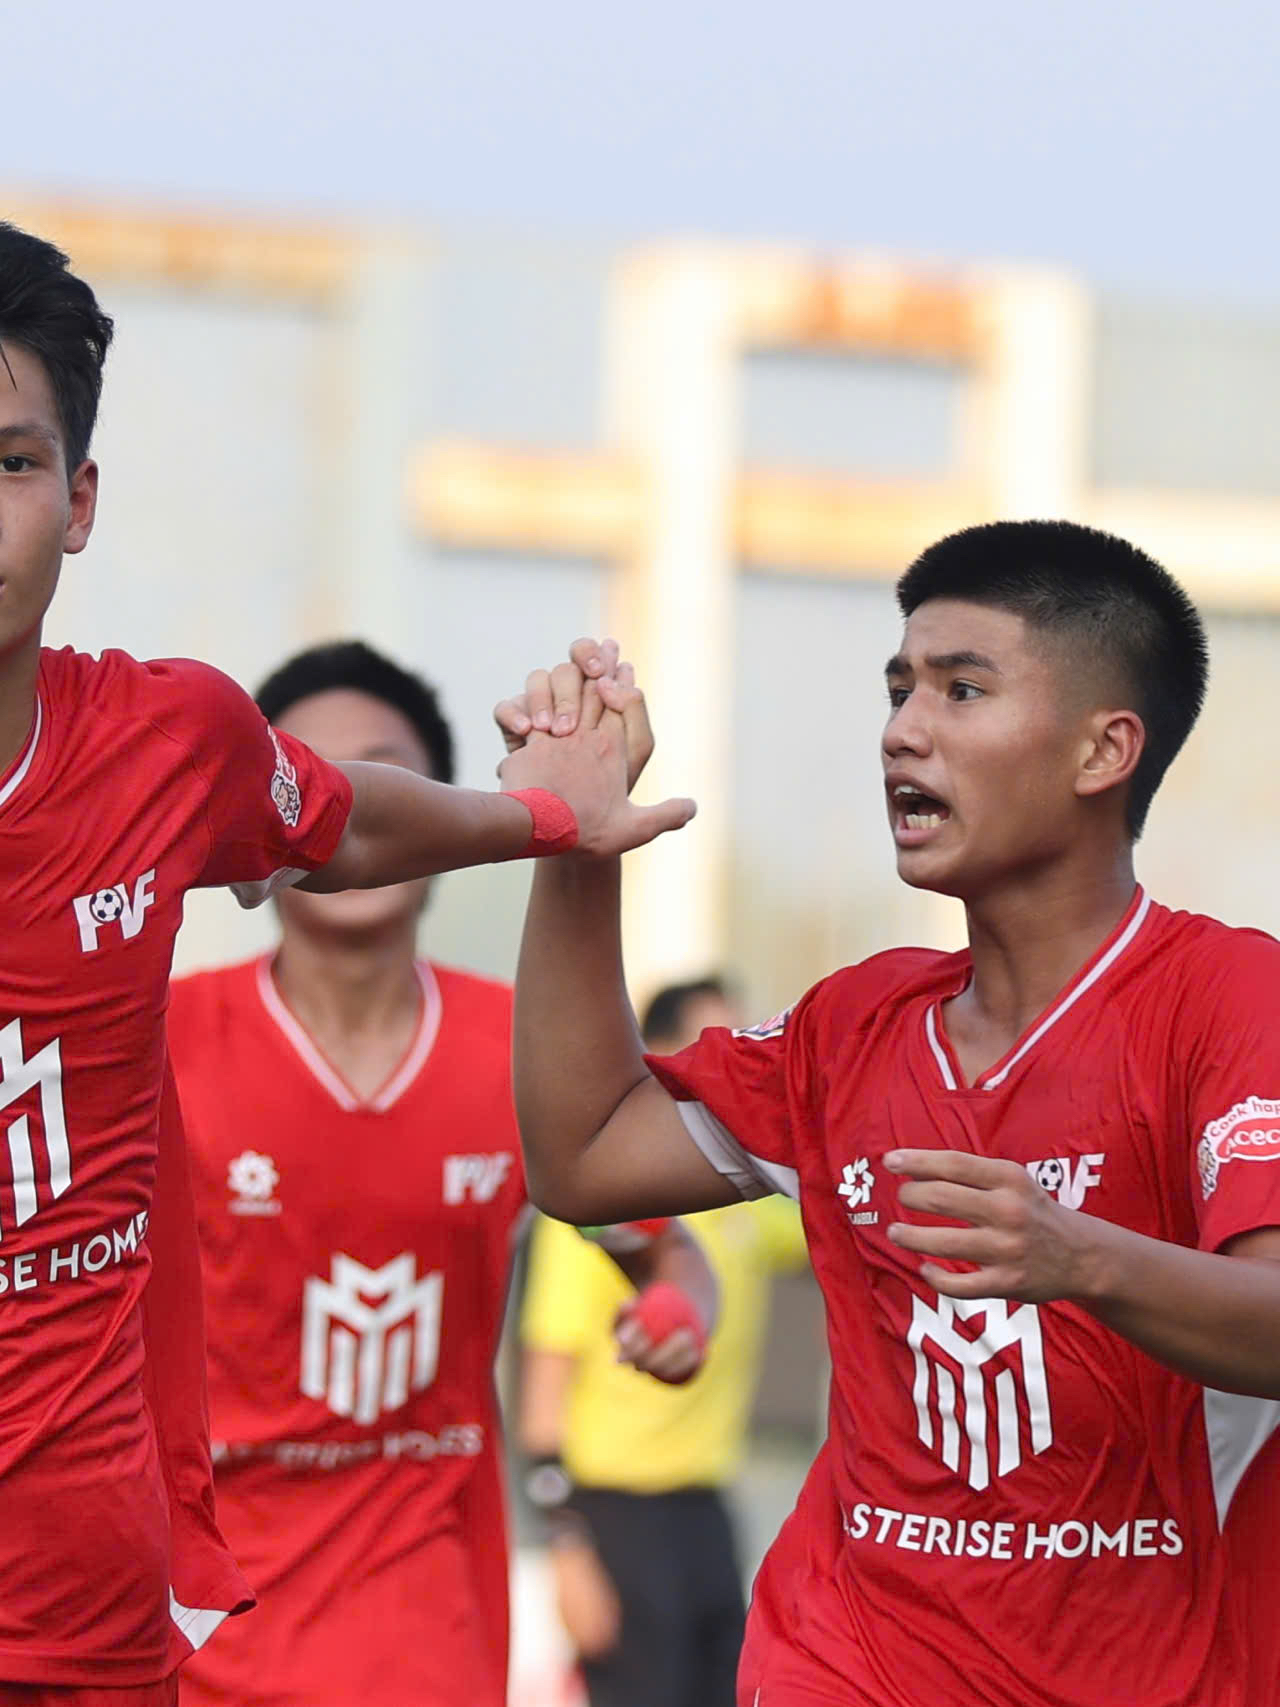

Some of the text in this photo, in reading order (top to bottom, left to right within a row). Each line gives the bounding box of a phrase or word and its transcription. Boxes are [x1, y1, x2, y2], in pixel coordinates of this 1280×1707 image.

[73, 867, 156, 953] PVF
[1210, 1105, 1247, 1137] Cook
[840, 1502, 1184, 1560] STERISE HOMES
